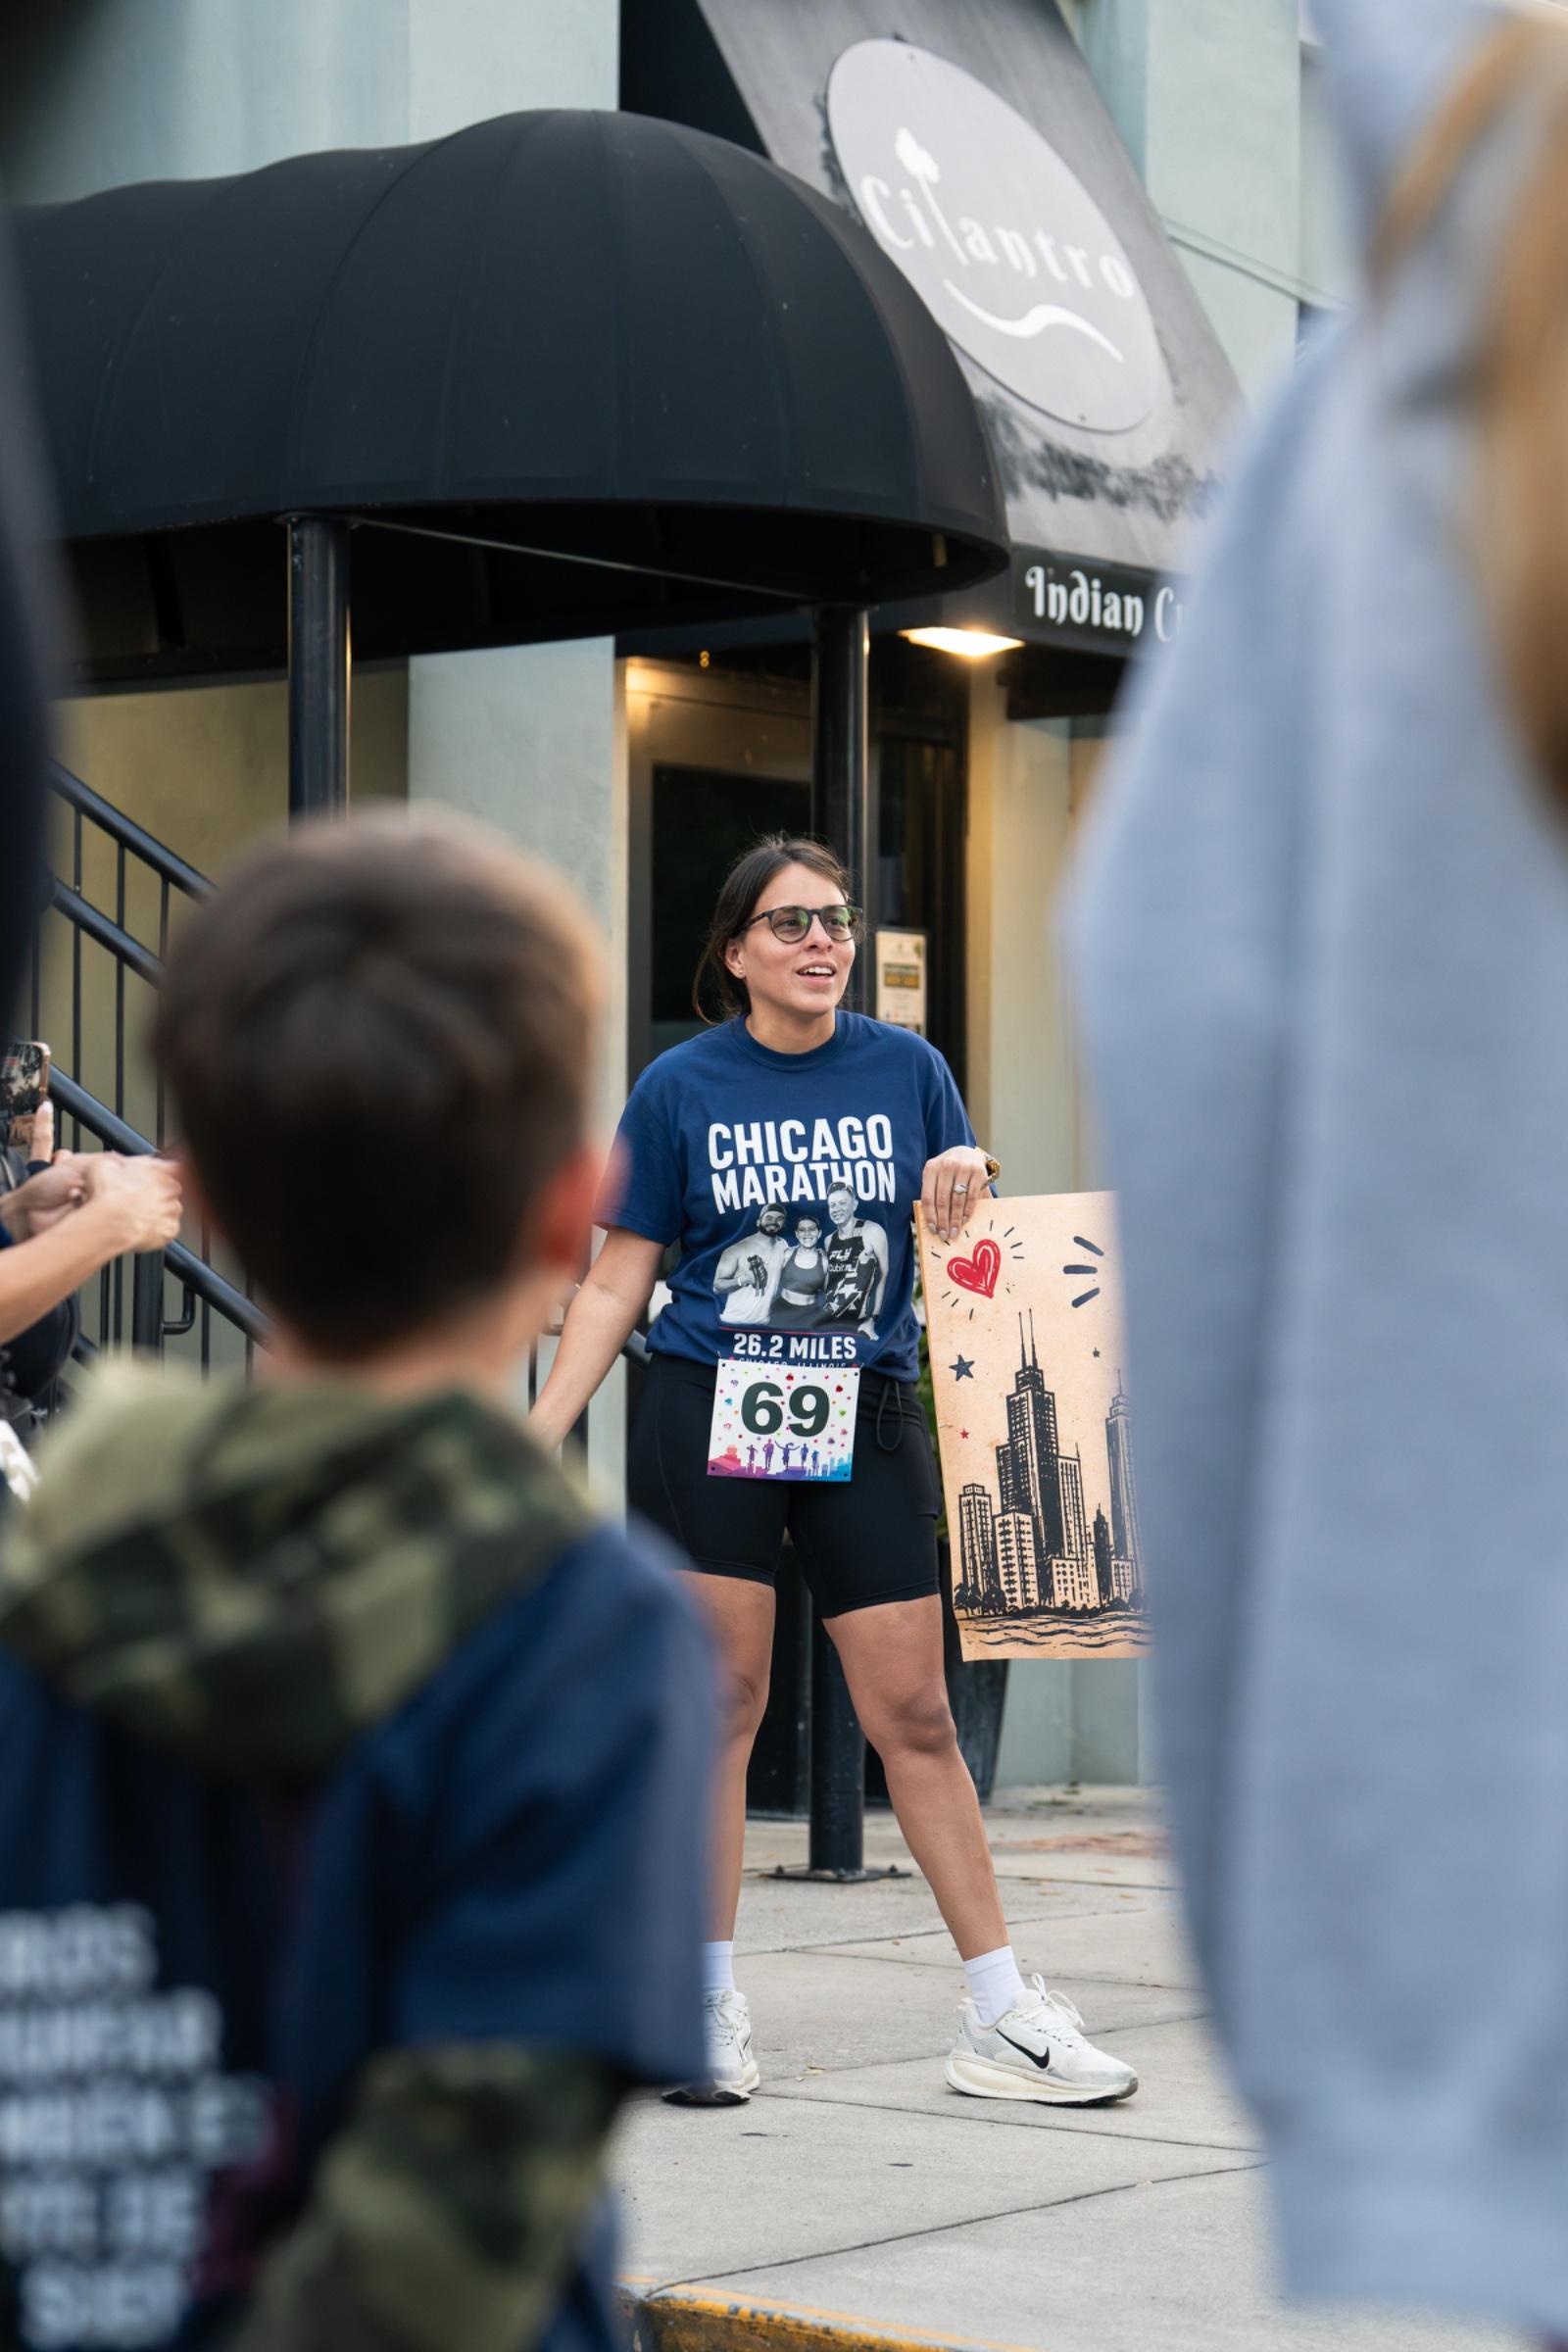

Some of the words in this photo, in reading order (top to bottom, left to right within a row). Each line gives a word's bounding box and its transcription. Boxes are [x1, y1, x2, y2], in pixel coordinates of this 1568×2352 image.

[860, 127, 1135, 298] Cilantro
[1025, 565, 1145, 636] Indian
[709, 1114, 893, 1170] CHICAGO
[710, 1160, 896, 1214] MARATHON
[733, 1333, 783, 1357] 26.2
[789, 1336, 857, 1359] MILES
[741, 1382, 830, 1438] 69
